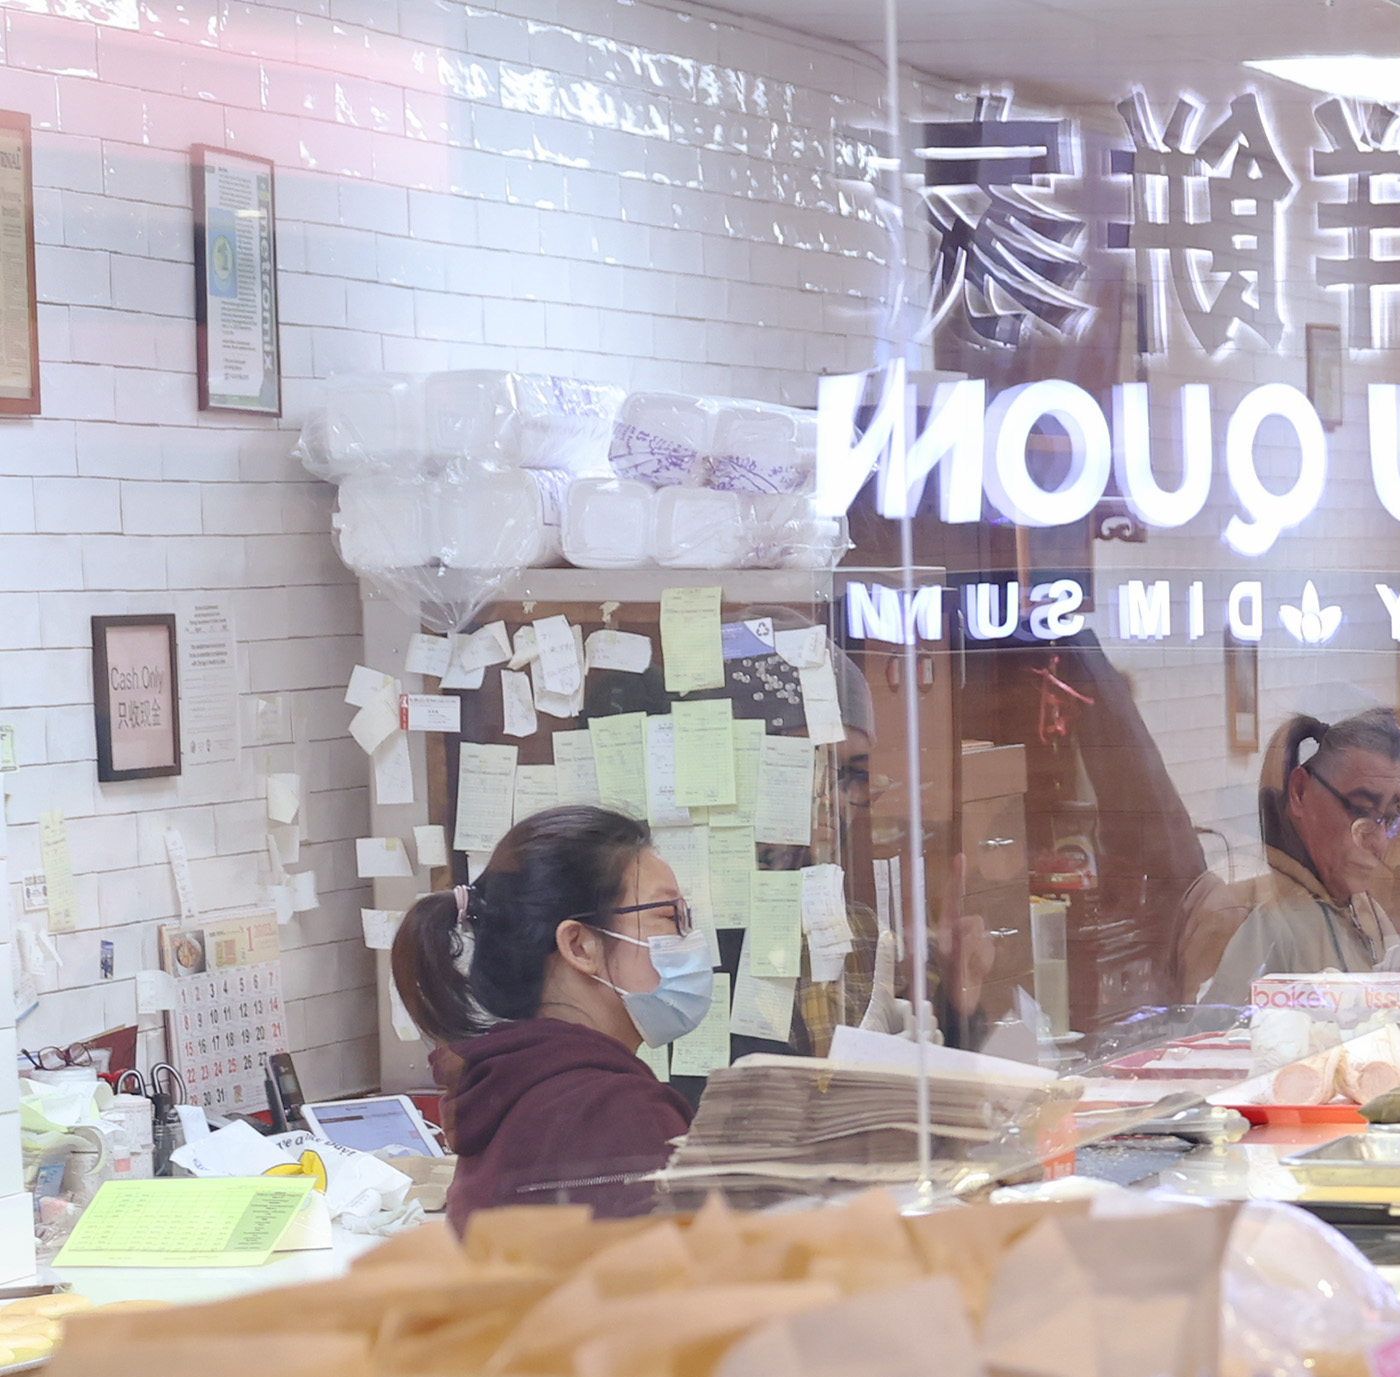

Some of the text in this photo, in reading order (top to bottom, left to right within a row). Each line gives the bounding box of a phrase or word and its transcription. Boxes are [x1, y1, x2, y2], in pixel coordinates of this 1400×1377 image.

[110, 665, 163, 694] Cash Only
[117, 699, 162, 729] 只收现金
[181, 973, 274, 1003] 1 2 3 4 5 6 7
[1253, 986, 1345, 1013] bakery
[184, 997, 279, 1030] 8 9 10 11 12 13 14
[185, 1024, 281, 1056] 15 16 17 18 19 20 21
[187, 1069, 196, 1083] 22
[201, 1066, 210, 1080] 23
[214, 1062, 223, 1076] 24
[228, 1059, 236, 1073] 25
[244, 1055, 252, 1069] 26
[204, 1091, 211, 1106] 30
[216, 1088, 225, 1102] 31
